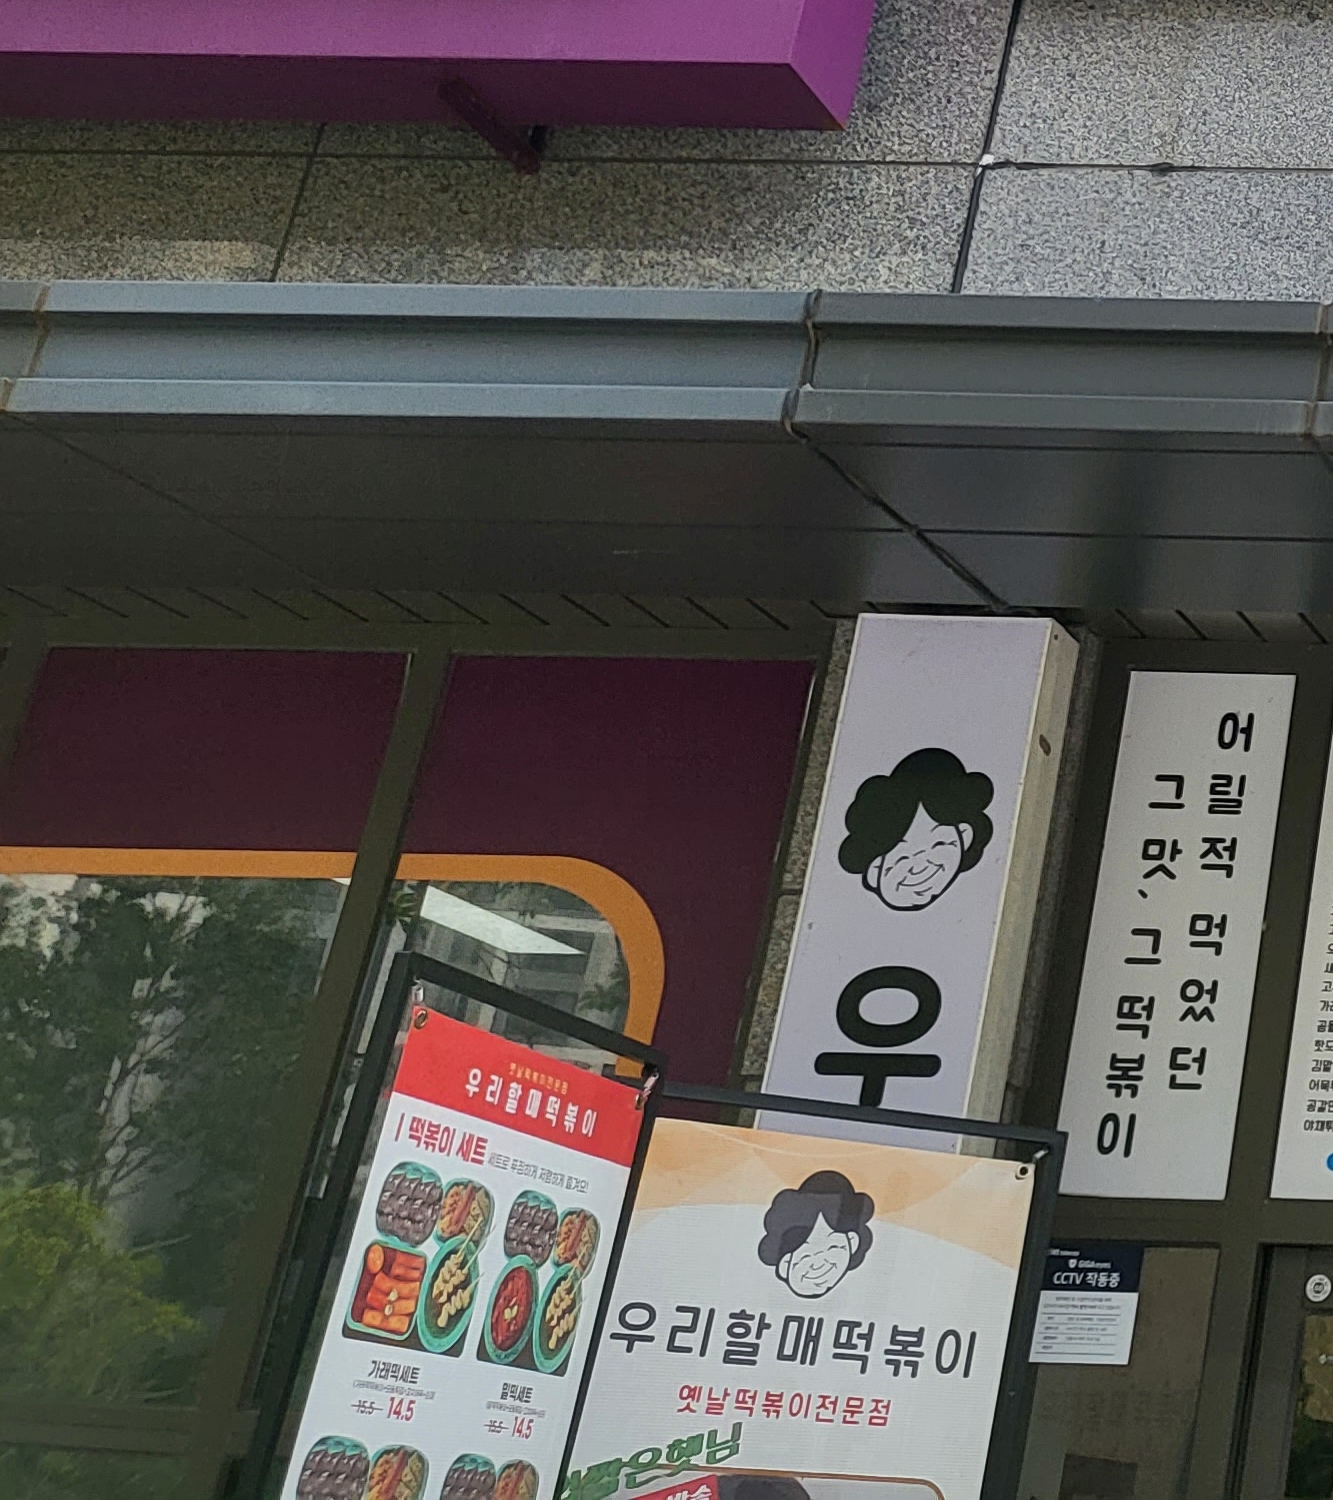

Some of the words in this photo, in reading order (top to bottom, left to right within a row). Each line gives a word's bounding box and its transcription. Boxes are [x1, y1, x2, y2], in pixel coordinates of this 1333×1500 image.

[1199, 711, 1255, 879] 어릴적
[1168, 913, 1228, 1091] 먹었던
[465, 1067, 598, 1138] 우리할매떡볶이
[408, 1116, 456, 1157] 떡볶이
[456, 1131, 489, 1165] 세트
[1053, 1272, 1084, 1285] CCTV
[1086, 1272, 1120, 1288] 작동중
[607, 1299, 979, 1381] 우리할매떡볶이
[367, 1360, 421, 1385] 가래떡세트
[500, 1382, 533, 1404] 밀떡세트
[387, 1397, 416, 1421] 14.5
[511, 1417, 533, 1439] 14.5
[676, 1381, 893, 1429] 옛날떡볶이전문점
